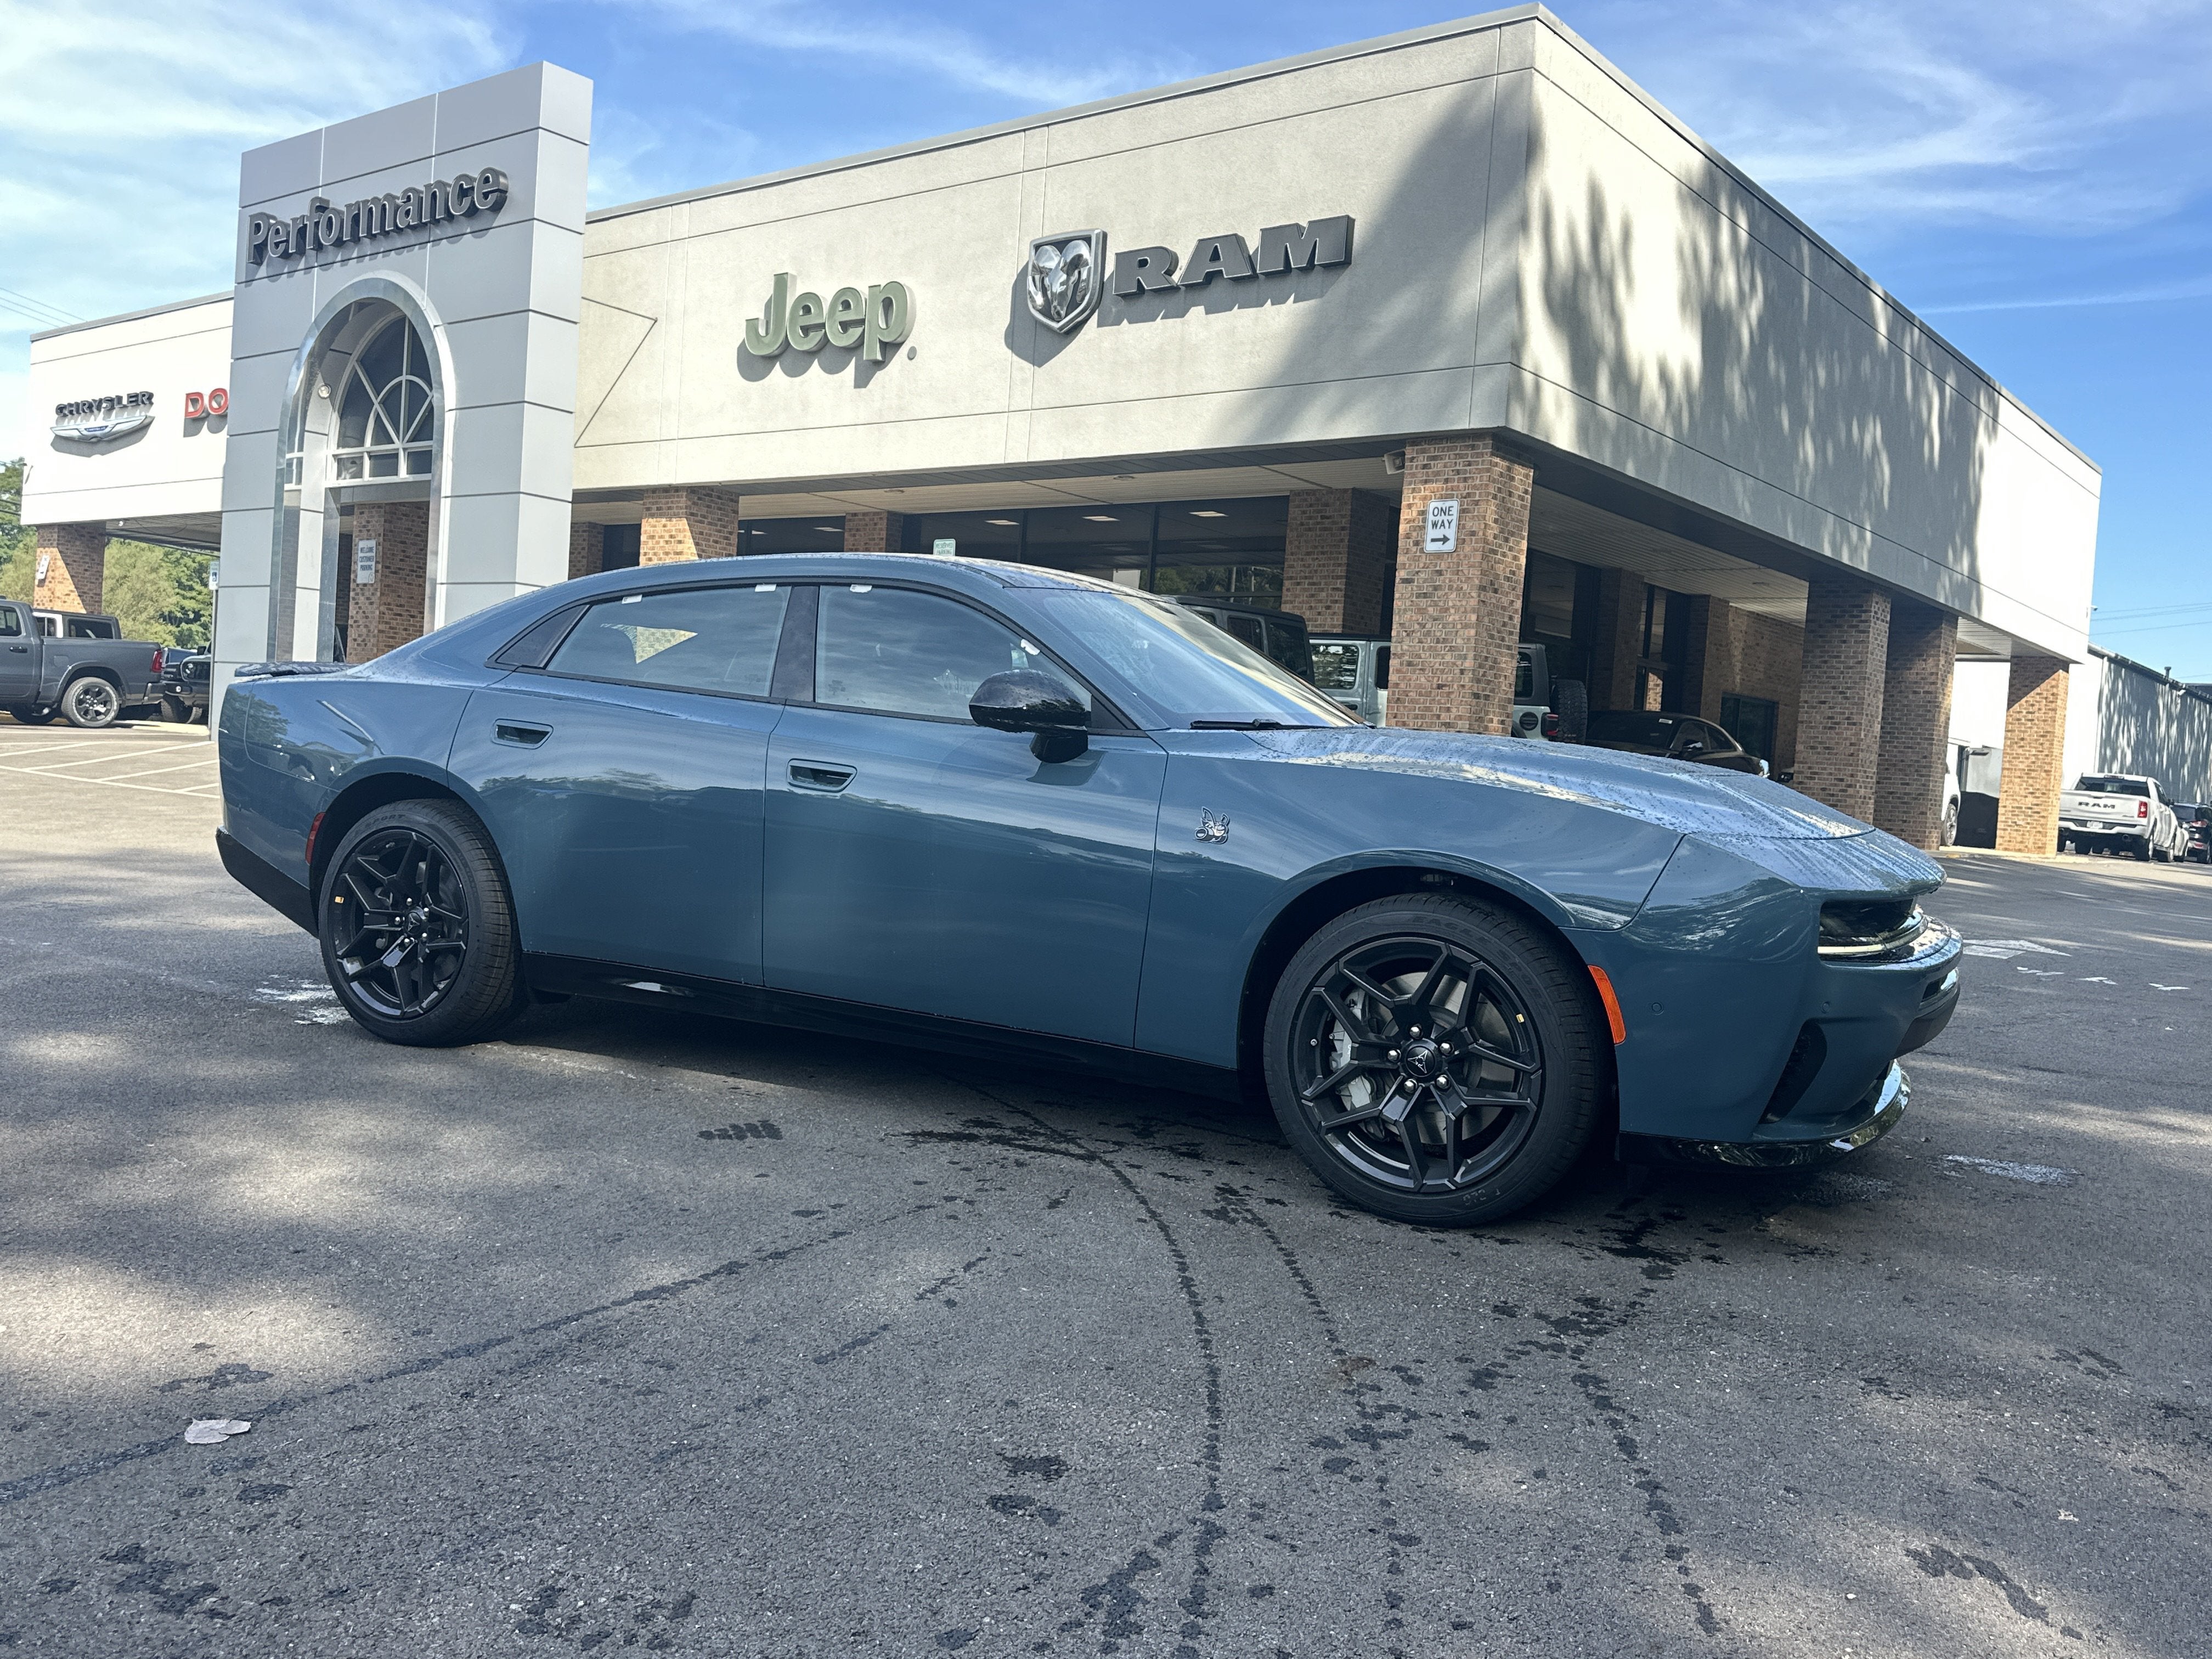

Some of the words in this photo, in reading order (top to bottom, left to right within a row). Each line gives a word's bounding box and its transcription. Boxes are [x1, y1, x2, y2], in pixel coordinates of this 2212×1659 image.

[247, 167, 508, 265] Performance
[1113, 215, 1356, 297] RAM
[745, 272, 917, 362] Jeep
[55, 391, 154, 417] CHRYSLER
[1431, 518, 1453, 530] WAY
[1432, 506, 1454, 517] ONE
